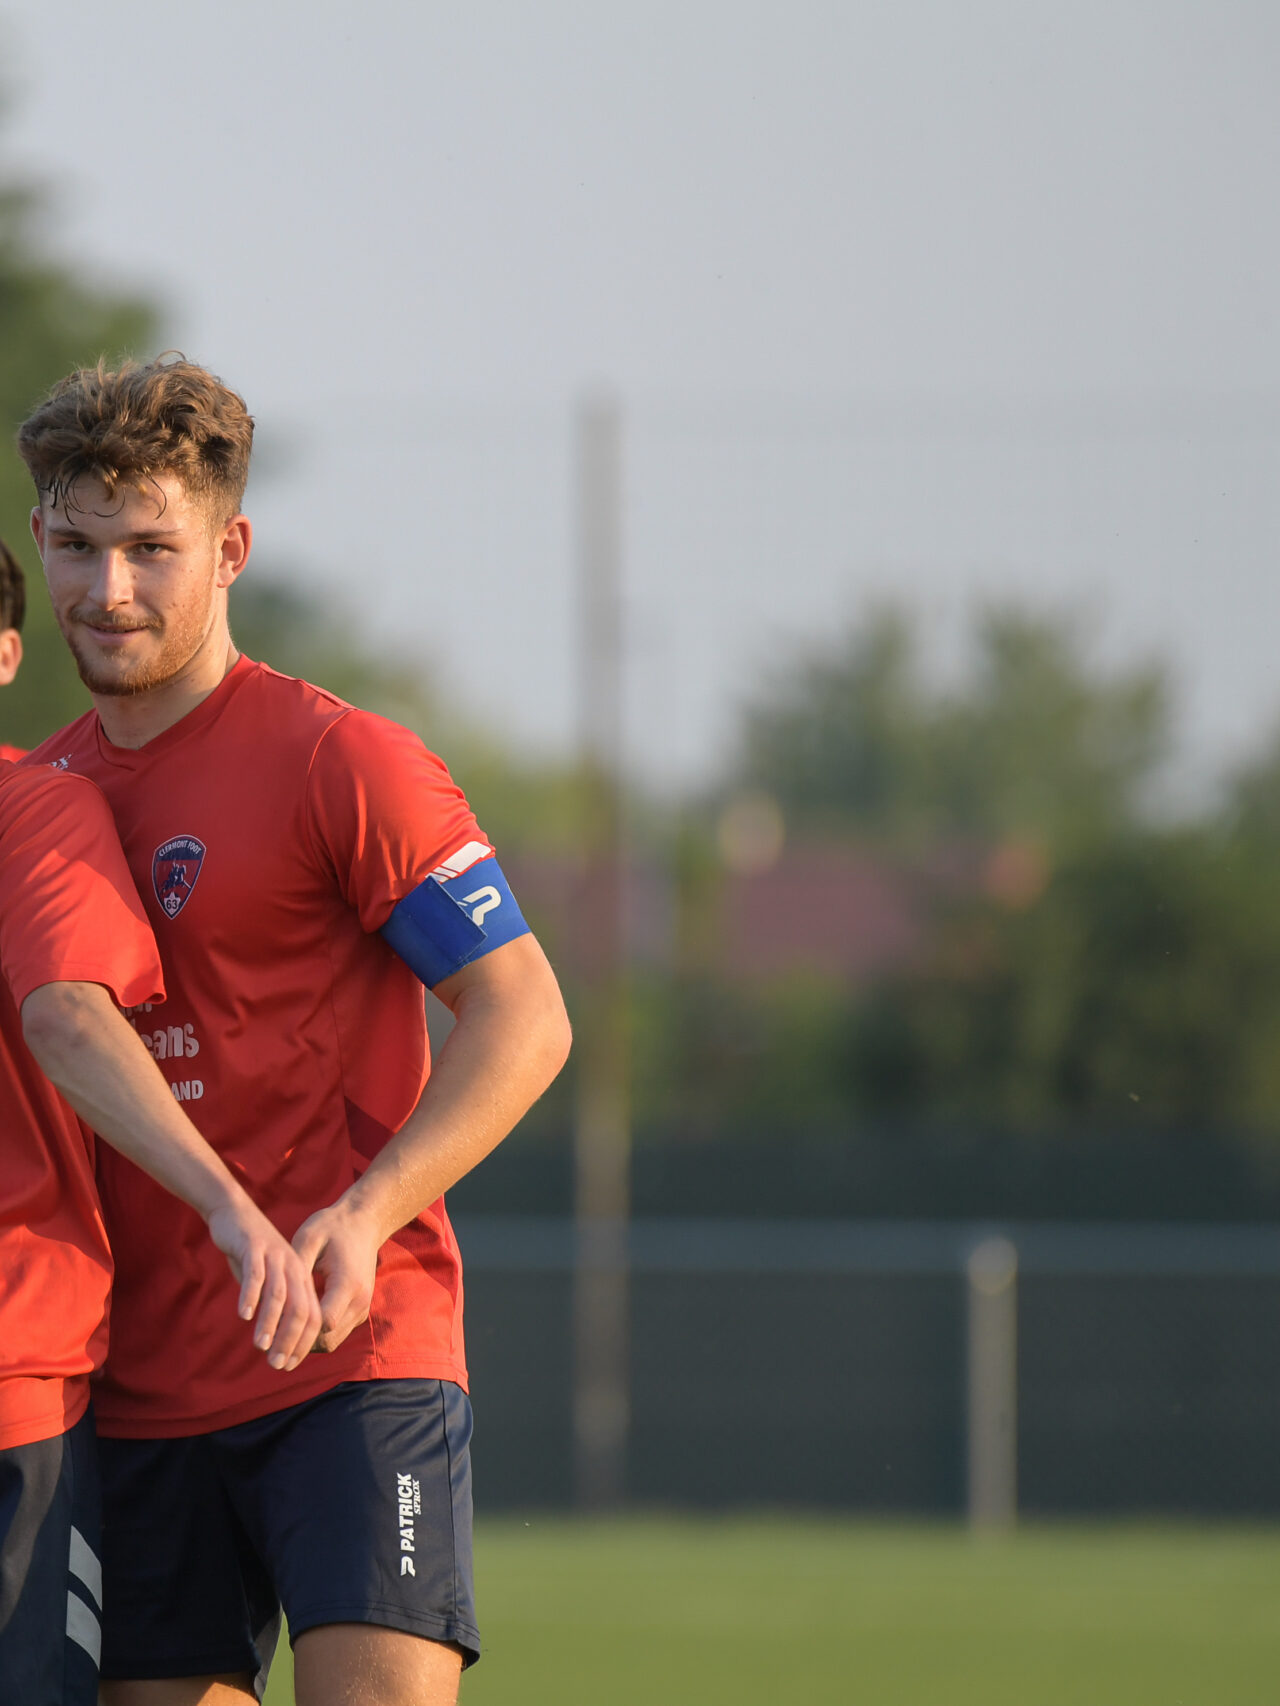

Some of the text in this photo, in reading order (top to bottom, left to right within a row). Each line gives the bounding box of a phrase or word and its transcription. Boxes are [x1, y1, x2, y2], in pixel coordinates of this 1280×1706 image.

[158, 839, 202, 857] CLERMONT FOOT
[166, 899, 178, 910] 63
[413, 1479, 422, 1516] SPROX
[397, 1472, 416, 1552] PATRICK
